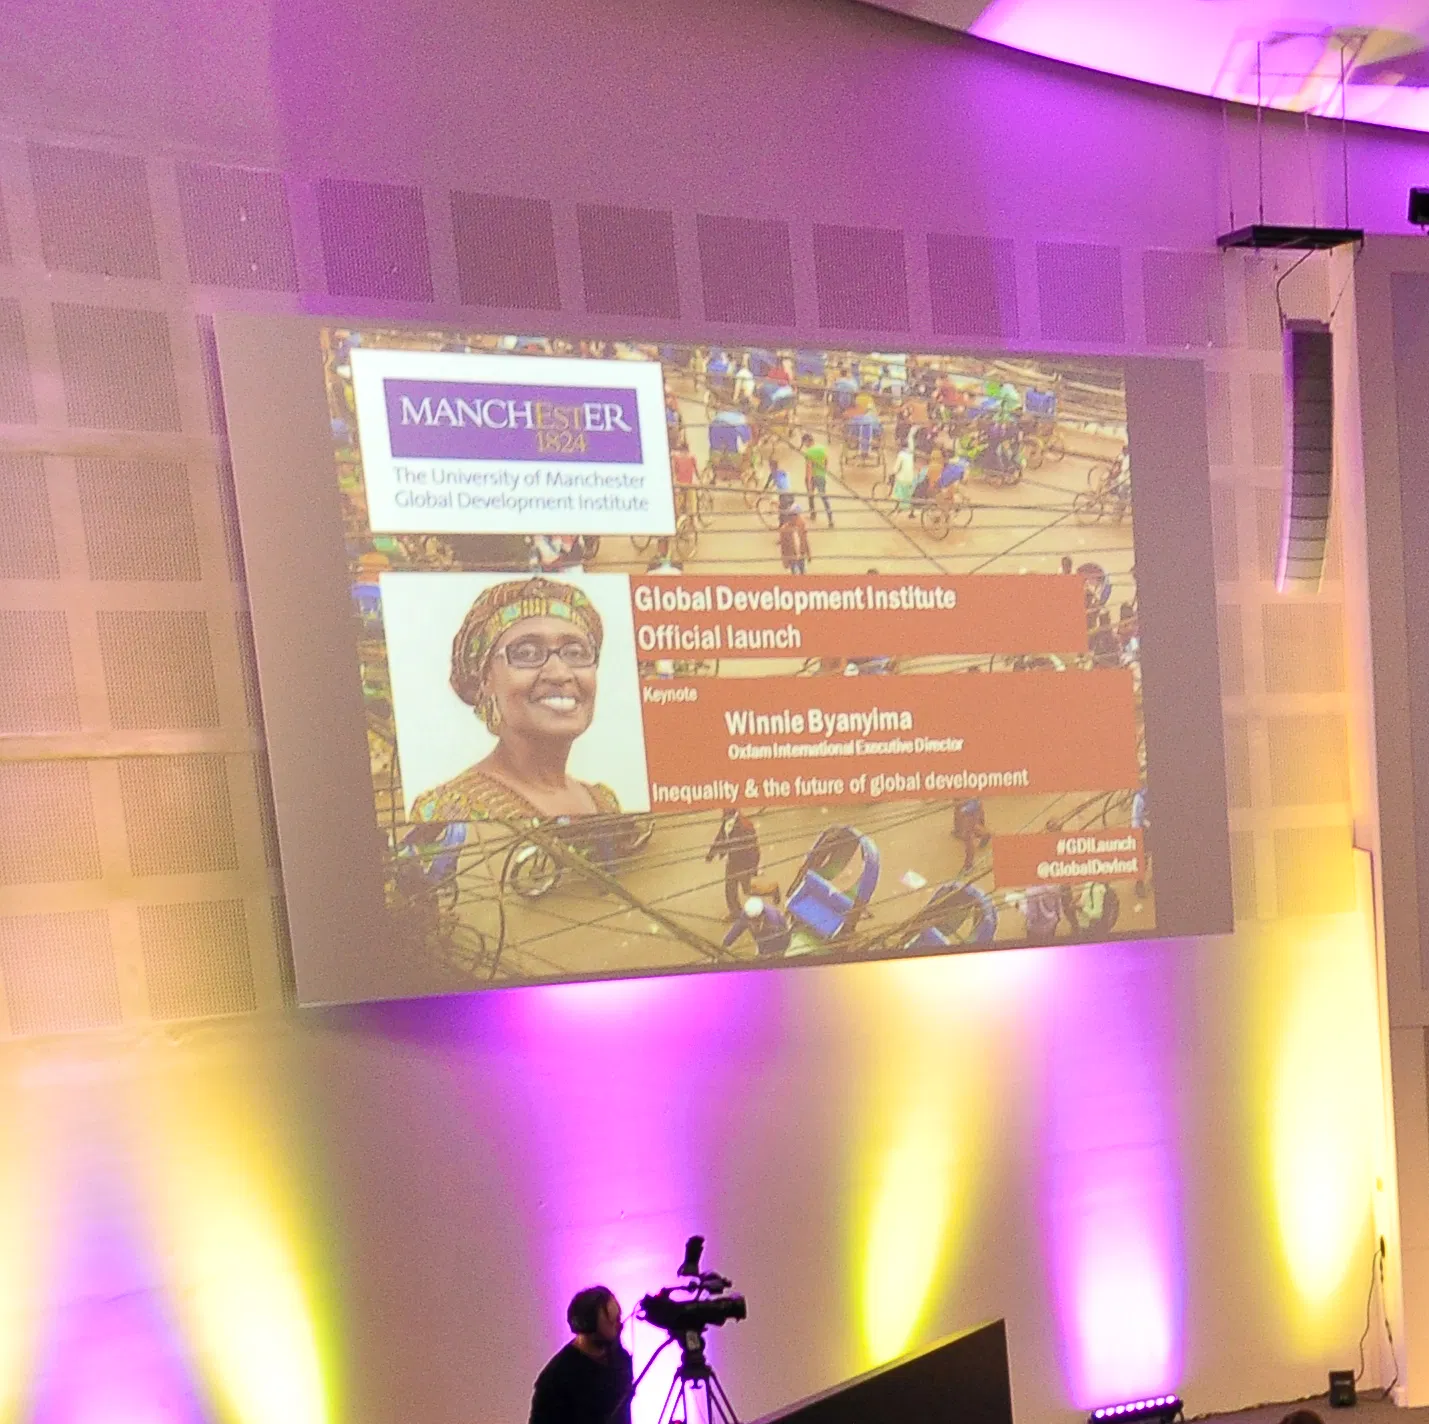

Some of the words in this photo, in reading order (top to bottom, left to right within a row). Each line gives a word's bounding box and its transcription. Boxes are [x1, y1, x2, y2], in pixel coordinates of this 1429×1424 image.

[400, 395, 632, 433] MANCHESTER
[536, 431, 588, 454] 1824
[394, 466, 427, 485] The
[431, 468, 519, 490] University
[524, 468, 542, 486] of
[546, 470, 647, 489] Manchester
[395, 489, 453, 509] Global
[458, 491, 575, 514] Development
[579, 495, 649, 513] Institute
[634, 586, 714, 612] Global
[717, 585, 864, 615] Development
[867, 585, 957, 610] Institute
[638, 625, 721, 651] Official
[727, 624, 801, 649] launch
[643, 685, 697, 705] Keynote
[725, 708, 804, 736] Winnie
[808, 707, 913, 738] Byanyima
[728, 741, 771, 760] Oxfam
[773, 740, 854, 759] International
[856, 738, 914, 757] Executive
[915, 737, 965, 755] Director
[652, 779, 738, 803] Inequality
[745, 778, 758, 798] &
[762, 777, 790, 798] the
[794, 776, 844, 797] future
[849, 774, 868, 795] of
[871, 772, 921, 798] global
[925, 767, 1029, 796] development
